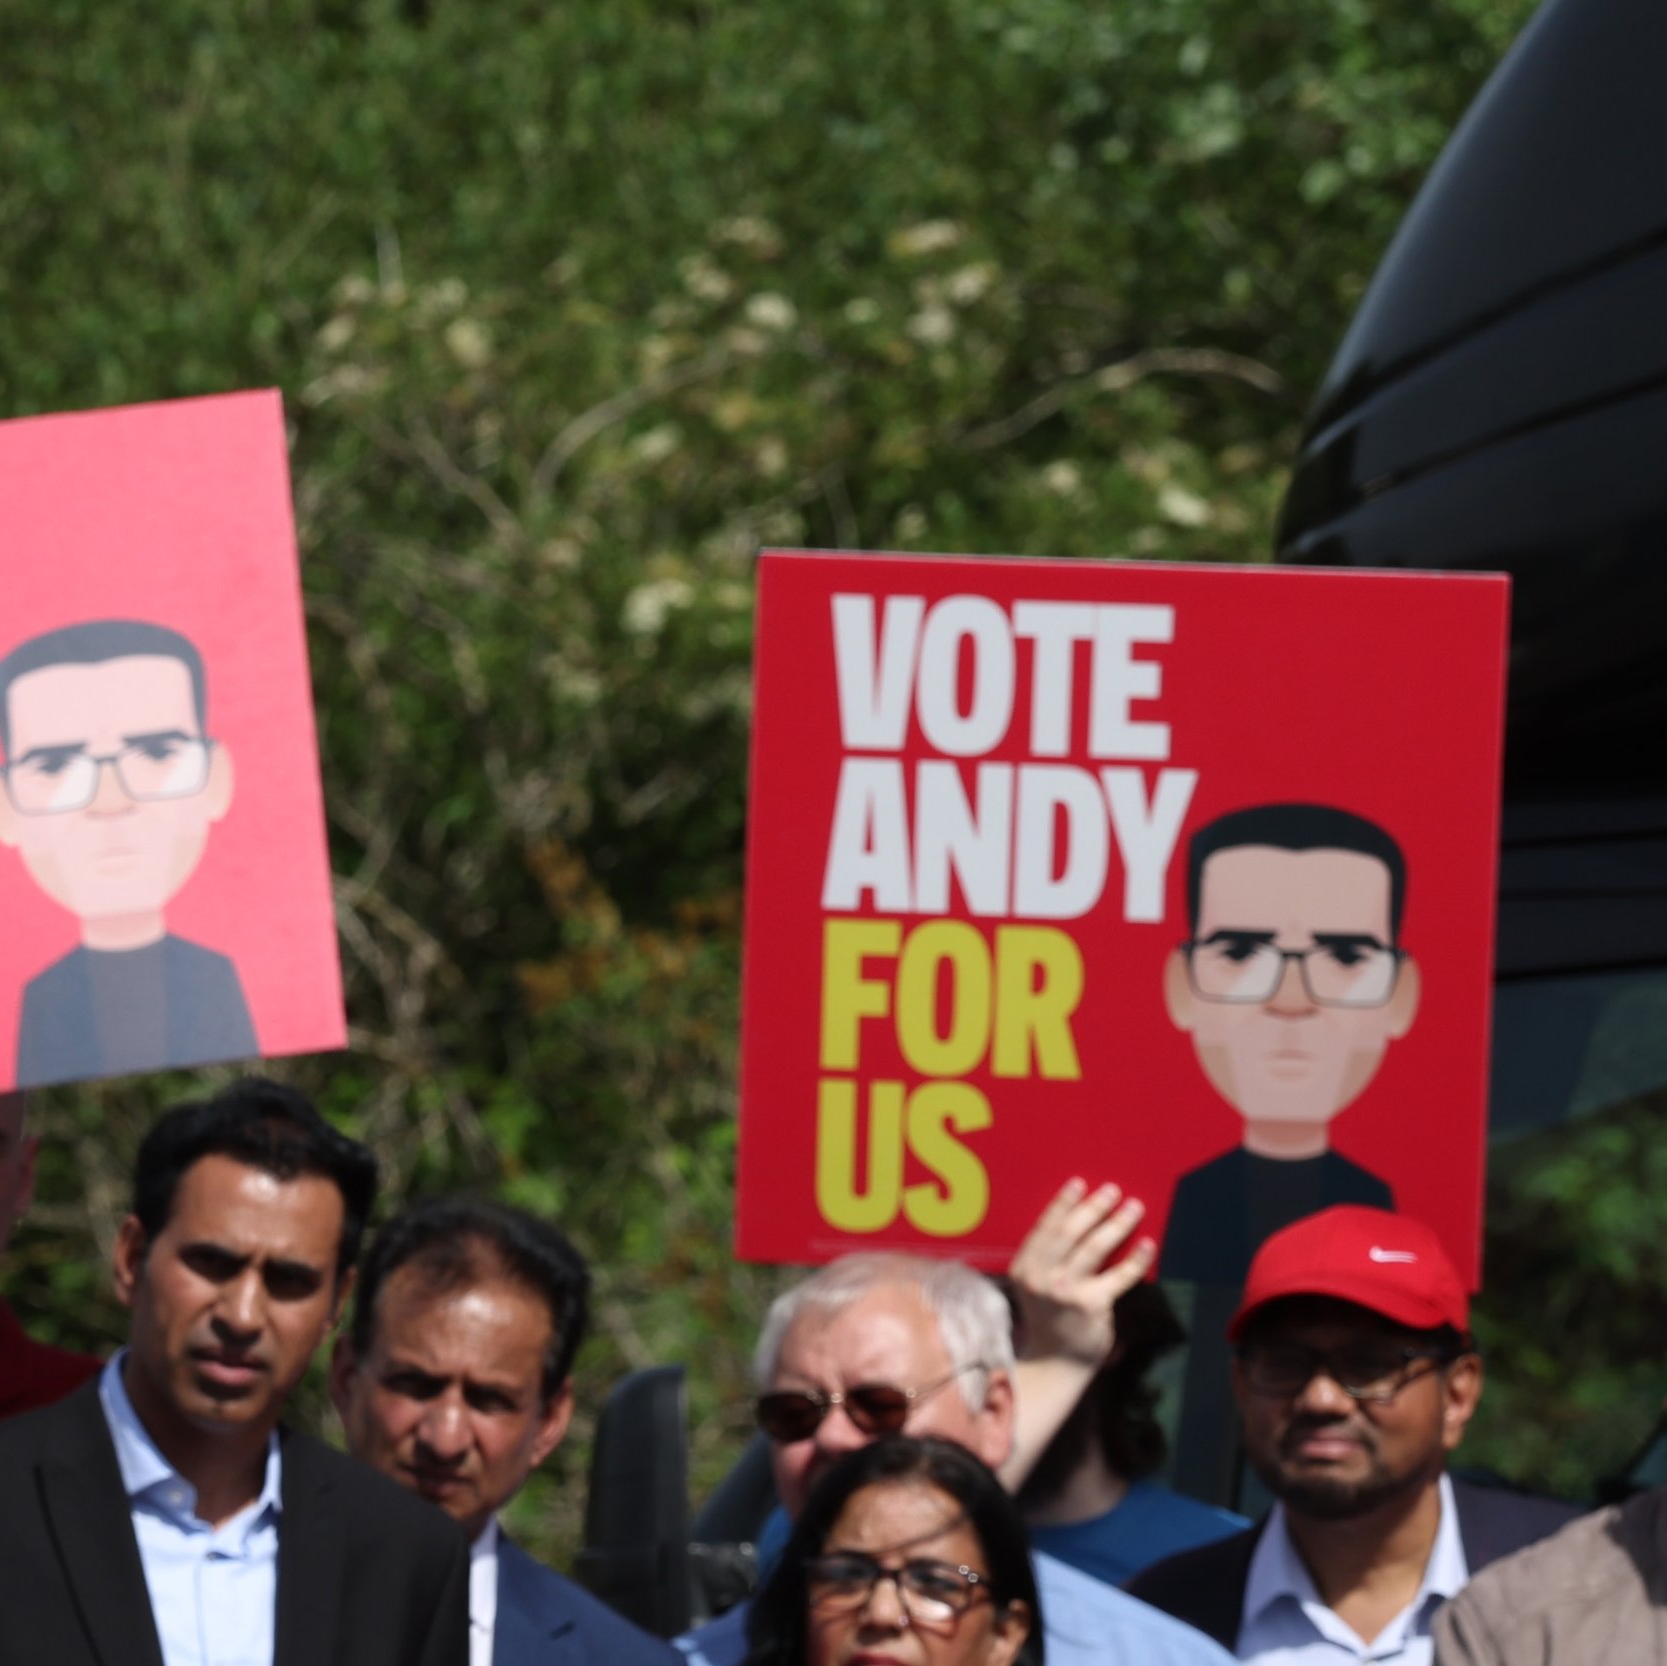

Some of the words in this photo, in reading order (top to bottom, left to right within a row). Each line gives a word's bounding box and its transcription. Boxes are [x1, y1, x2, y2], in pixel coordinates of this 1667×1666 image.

[831, 594, 1175, 760] VOTE
[822, 758, 1198, 922] ANDY
[819, 919, 1084, 1080] FOR
[816, 1080, 993, 1237] US
